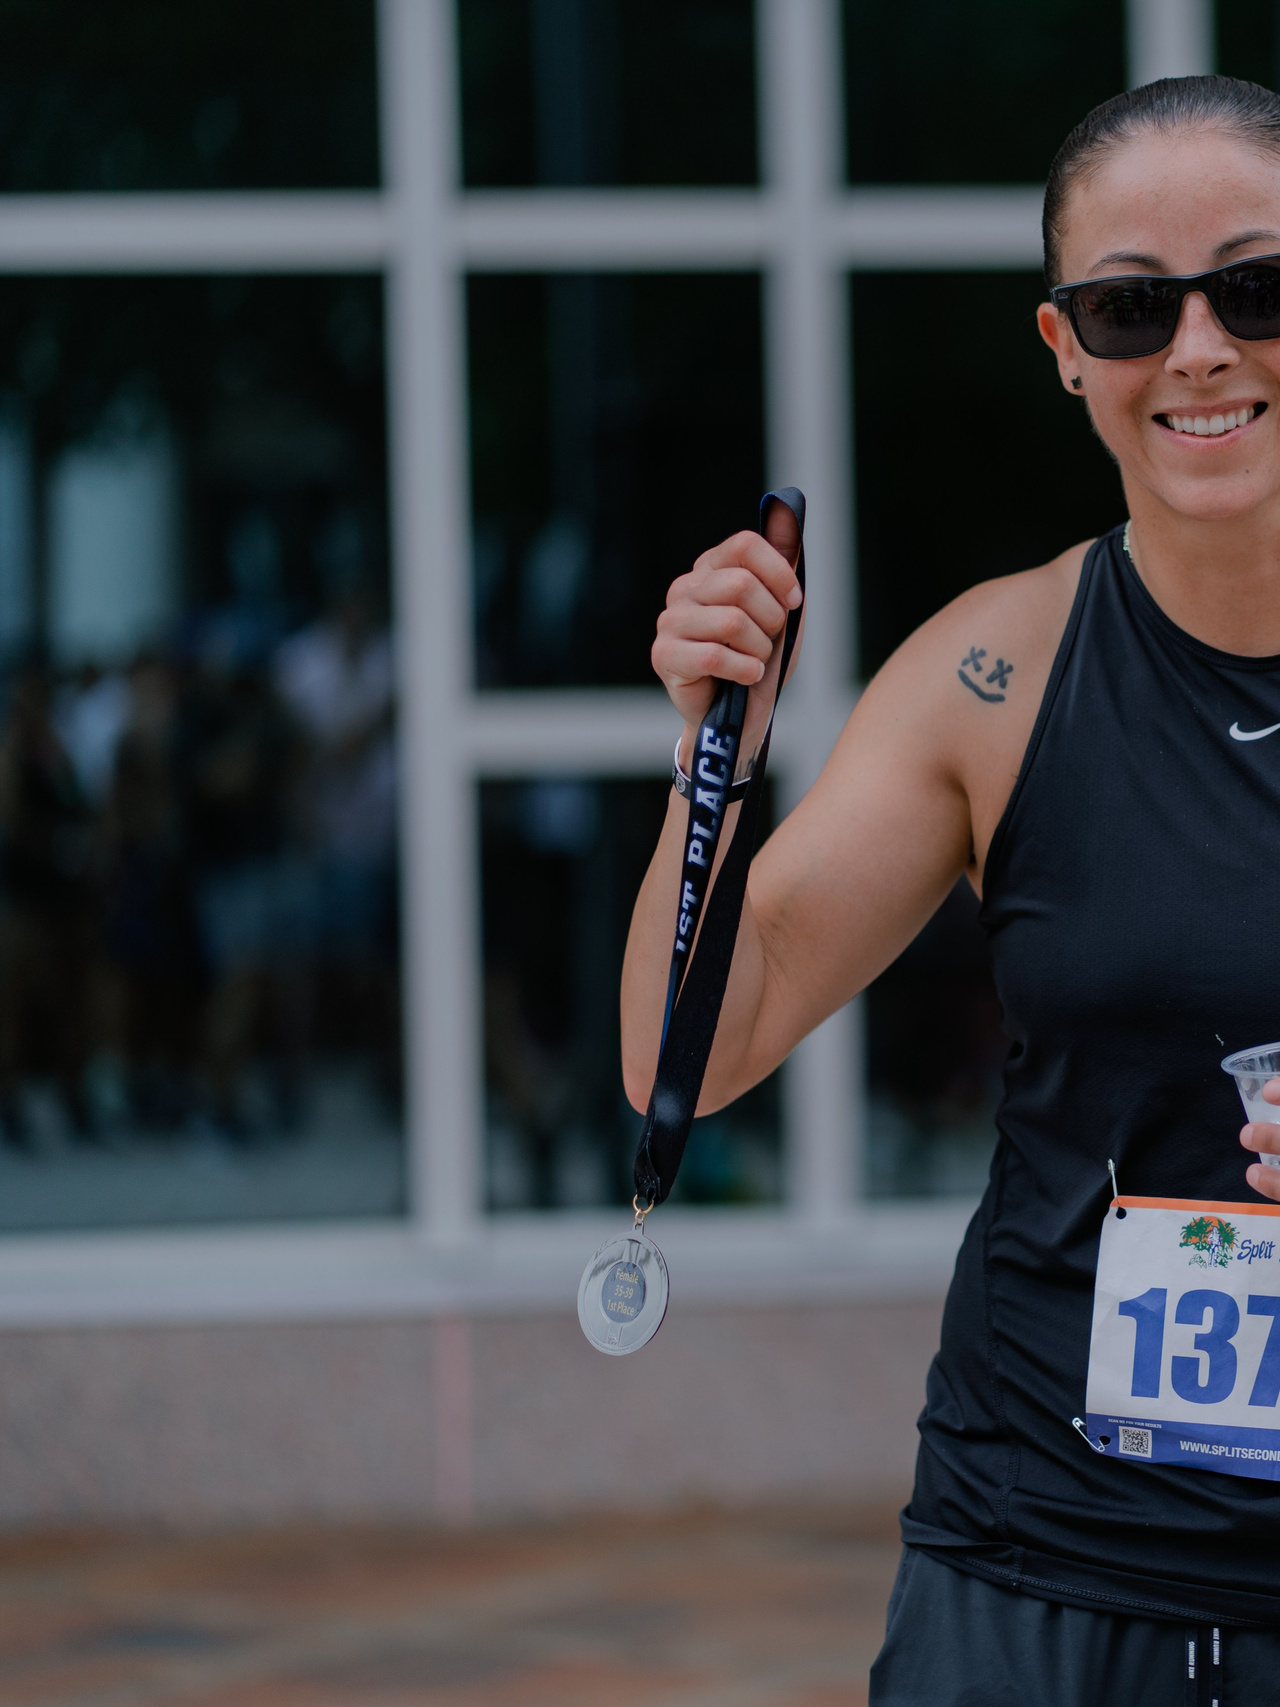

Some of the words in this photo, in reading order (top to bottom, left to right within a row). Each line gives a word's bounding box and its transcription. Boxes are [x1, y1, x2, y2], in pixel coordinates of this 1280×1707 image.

[688, 727, 735, 869] PLACE
[1237, 1239, 1276, 1264] Split
[616, 1268, 639, 1283] Female
[614, 1285, 634, 1299] 35-39
[607, 1299, 617, 1311] 1st
[617, 1302, 635, 1316] Place
